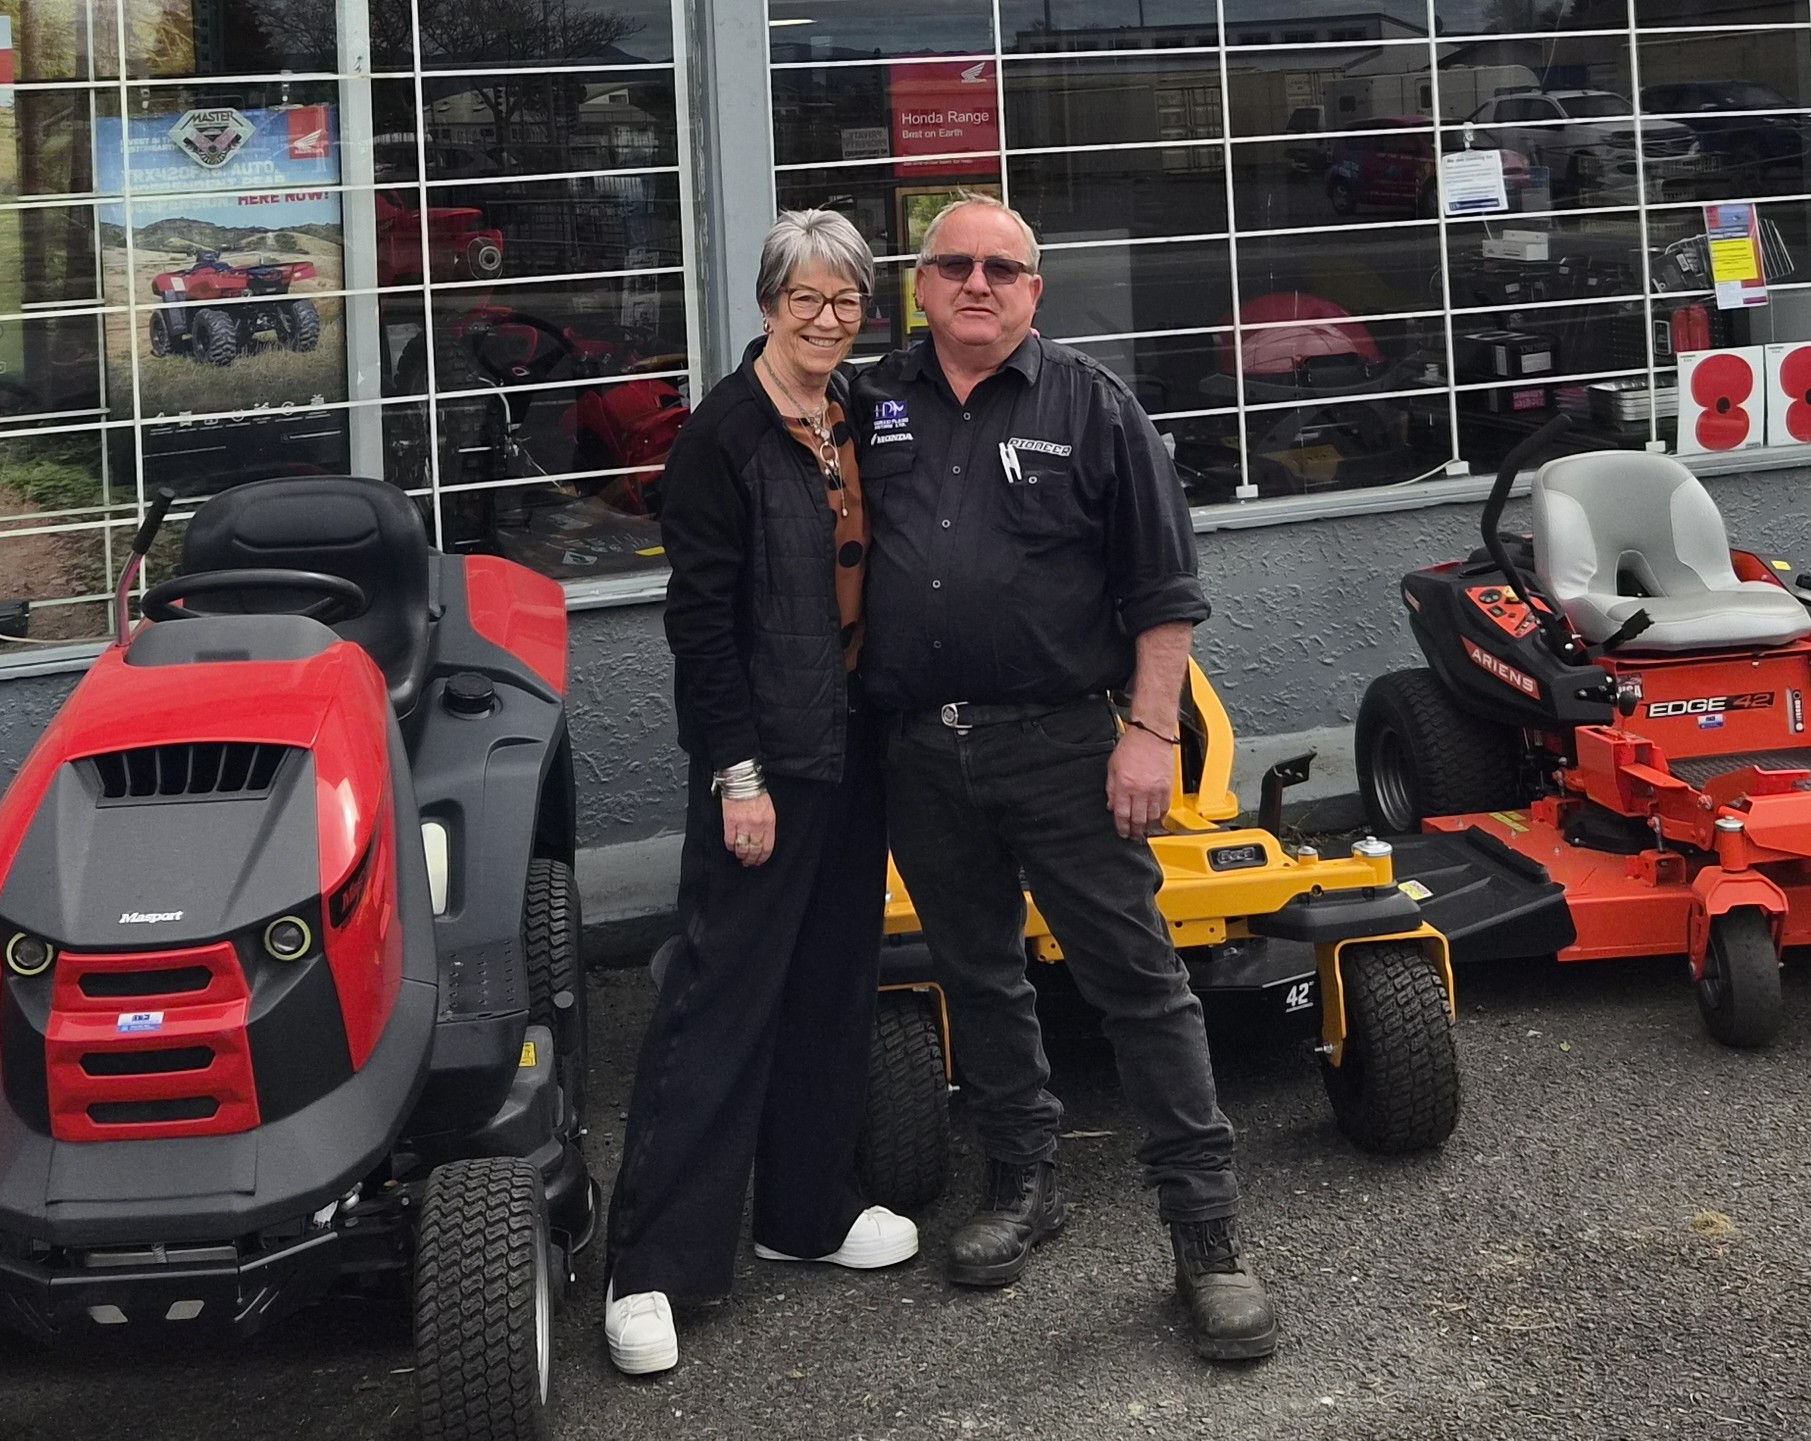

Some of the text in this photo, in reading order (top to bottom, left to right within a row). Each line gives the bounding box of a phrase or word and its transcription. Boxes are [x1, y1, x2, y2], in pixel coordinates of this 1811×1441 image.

[184, 110, 243, 125] MASTER
[901, 110, 990, 125] Honda Range
[938, 128, 963, 138] Earth
[237, 194, 280, 206] HERE
[285, 191, 329, 203] NOW!
[877, 433, 914, 444] HONDA
[1009, 438, 1072, 456] PIONEER
[1471, 648, 1535, 693] ARIENS
[1649, 693, 1770, 717] EDGE 42
[119, 910, 184, 923] Masport
